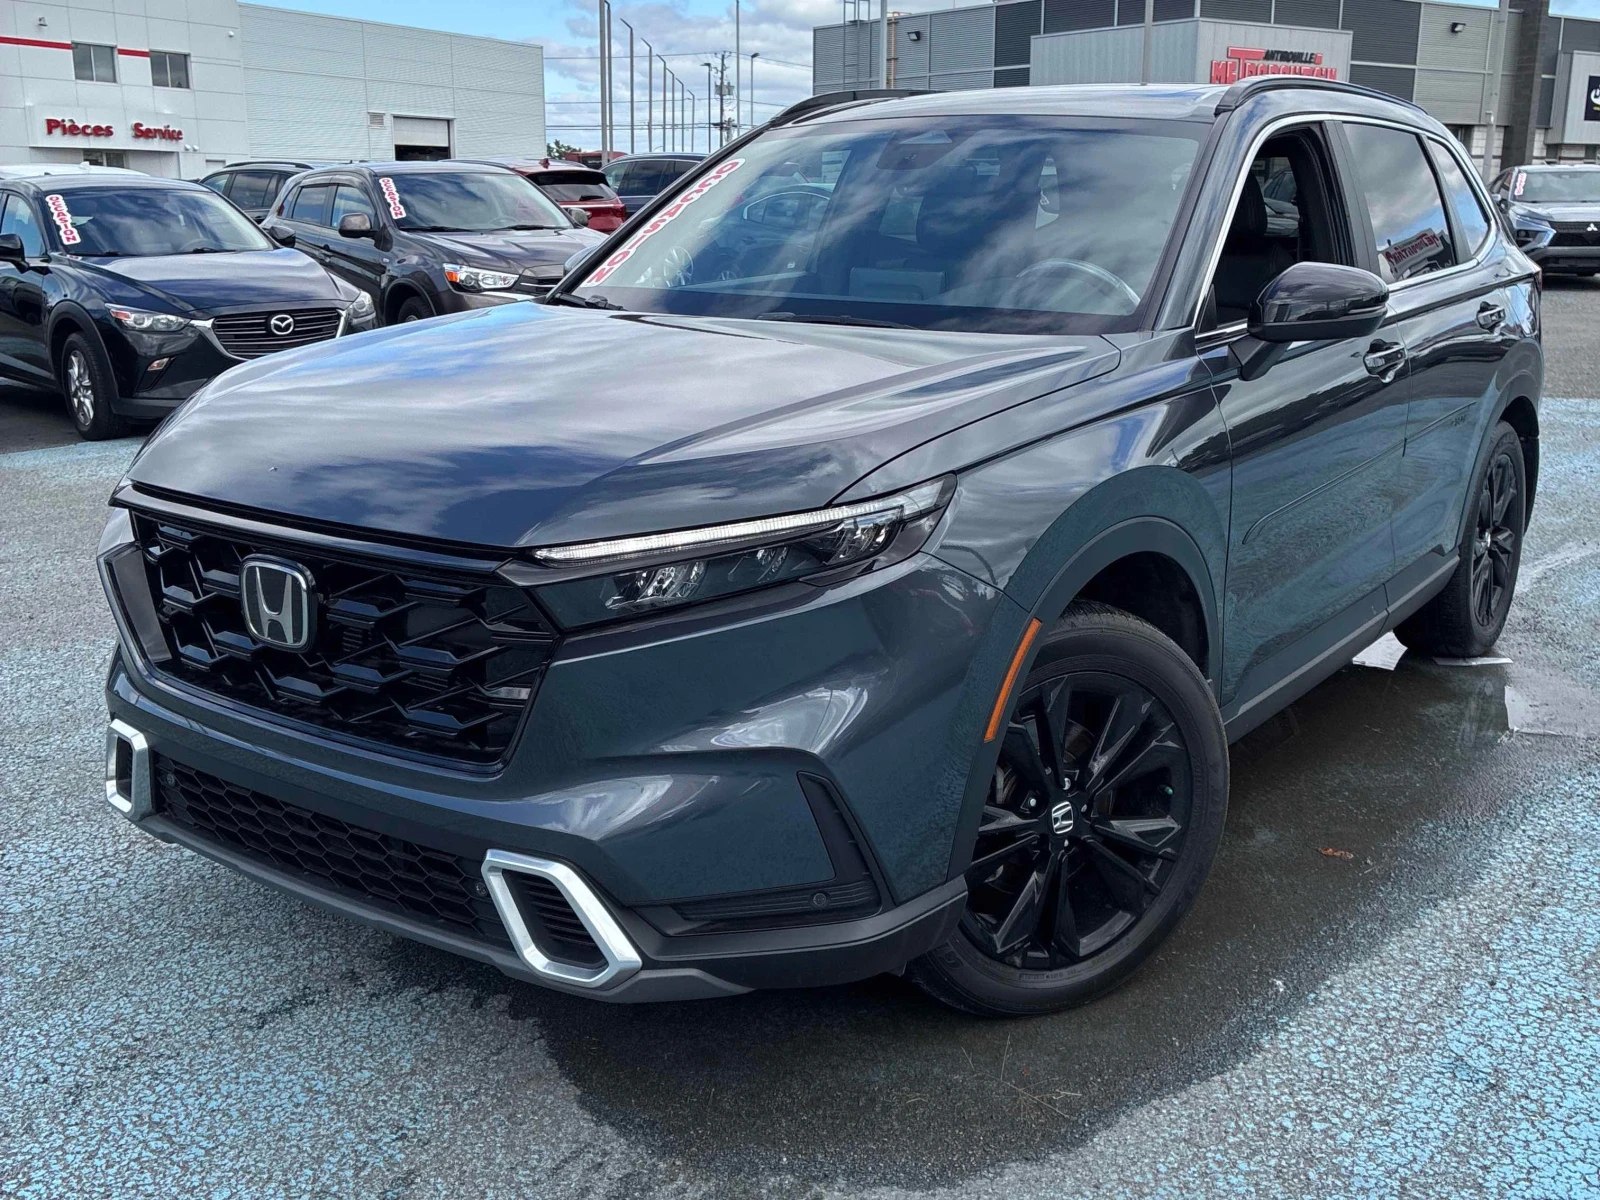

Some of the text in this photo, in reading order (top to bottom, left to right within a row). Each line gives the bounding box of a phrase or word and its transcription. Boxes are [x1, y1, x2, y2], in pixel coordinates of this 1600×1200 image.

[45, 118, 183, 141] Pièces Service
[48, 196, 78, 243] OCCASION
[381, 178, 404, 218] OCCASION
[586, 161, 740, 285] OCCASION
